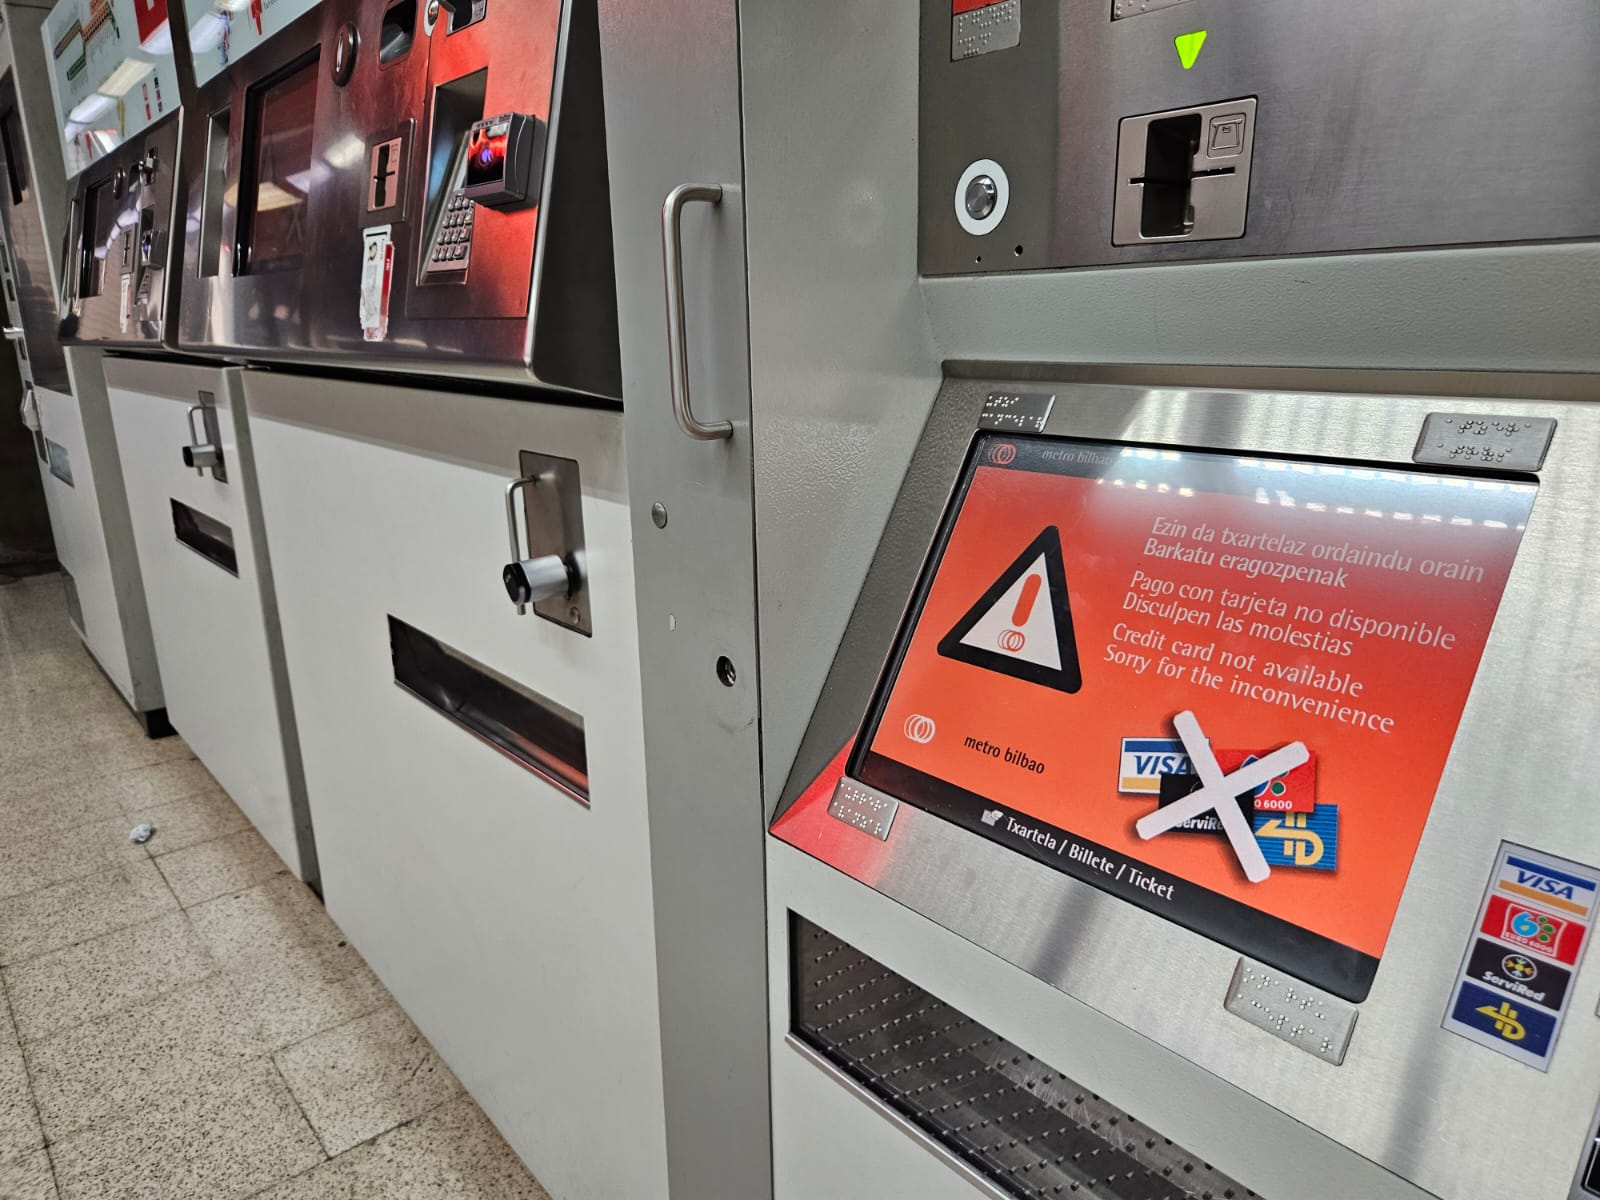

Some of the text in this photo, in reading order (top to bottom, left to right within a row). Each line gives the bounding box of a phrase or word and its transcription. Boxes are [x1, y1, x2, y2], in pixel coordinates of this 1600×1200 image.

[1041, 450, 1075, 462] metro
[1143, 537, 1350, 589] Barkatu eragozpenak
[1151, 516, 1484, 583] Ezin da txartelaz ordaindu orain
[1122, 591, 1354, 657] Disculpen las molestias
[1130, 570, 1457, 651] Pago con tarjeta no disponible
[1112, 622, 1364, 698] Credit card not available
[1103, 643, 1396, 735] Sorry for the inconvenience
[964, 735, 1046, 775] metro bilbao
[1134, 755, 1192, 775] VISA
[1176, 815, 1225, 830] erviRe
[1263, 799, 1294, 810] 6000
[1006, 816, 1058, 850] Txartela
[1068, 843, 1115, 875] Billete
[1128, 867, 1176, 901] Ticket
[1517, 869, 1575, 900] VISA
[1482, 970, 1547, 1002] ServiRed
